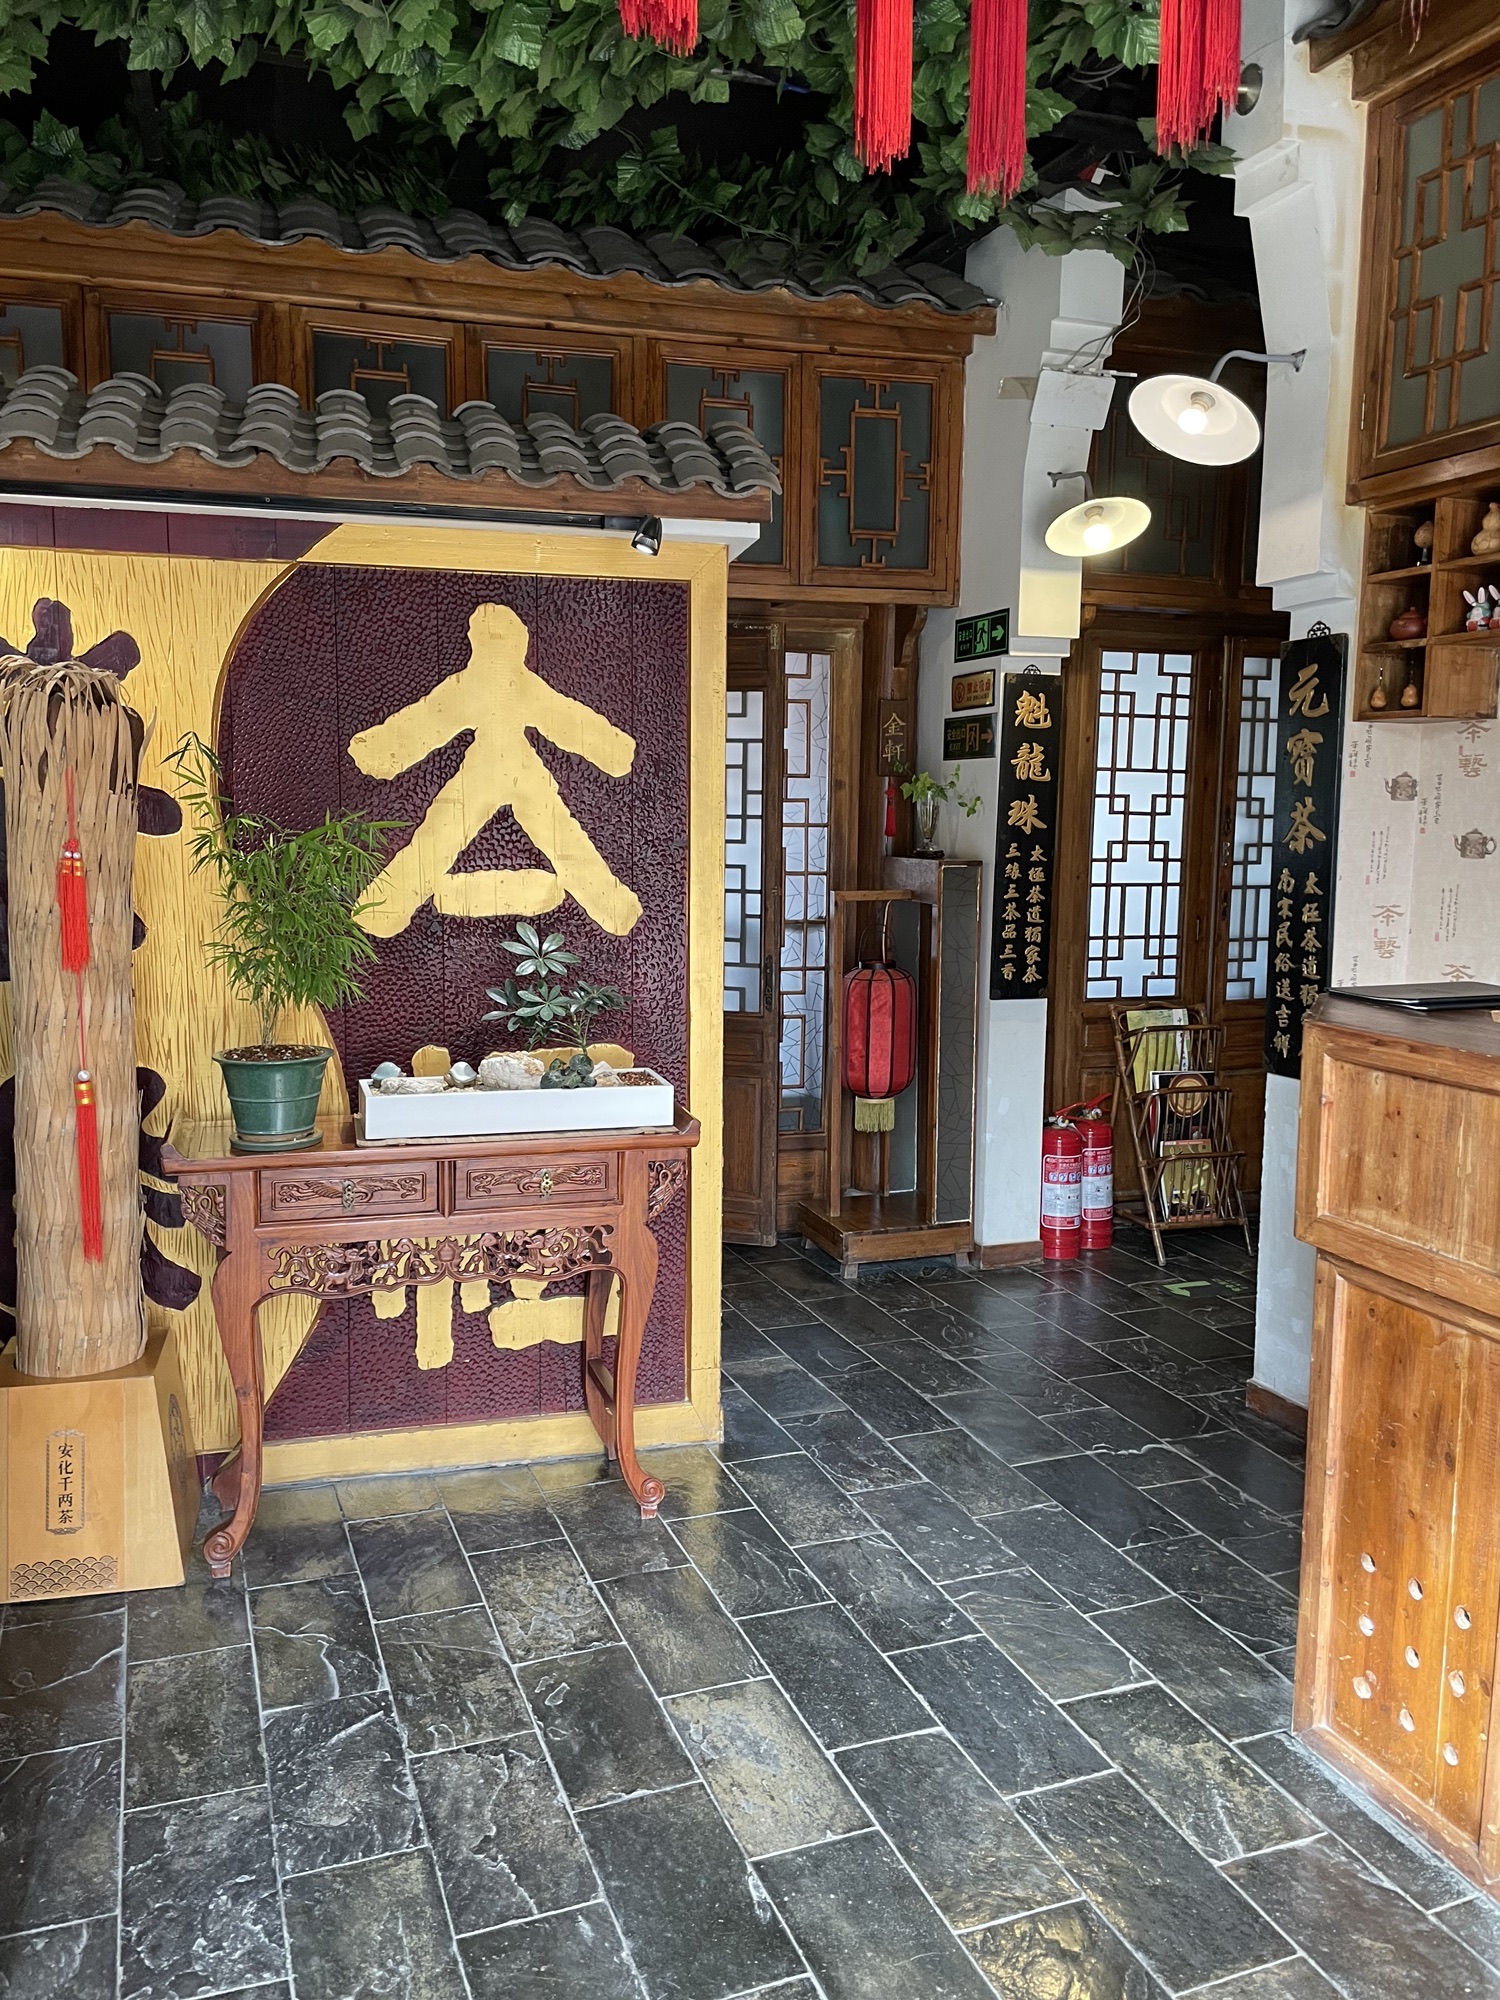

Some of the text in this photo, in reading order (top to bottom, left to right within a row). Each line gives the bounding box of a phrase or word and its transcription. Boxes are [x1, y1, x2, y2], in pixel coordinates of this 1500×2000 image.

[882, 712, 907, 763] 金軒
[946, 728, 966, 741] 安全出口
[949, 743, 961, 751] EXIT
[1007, 690, 1053, 835] 魁龍珠
[1456, 719, 1492, 778] 茶藝
[1371, 903, 1405, 959] 茶藝
[57, 1442, 74, 1524] 安化千两茶
